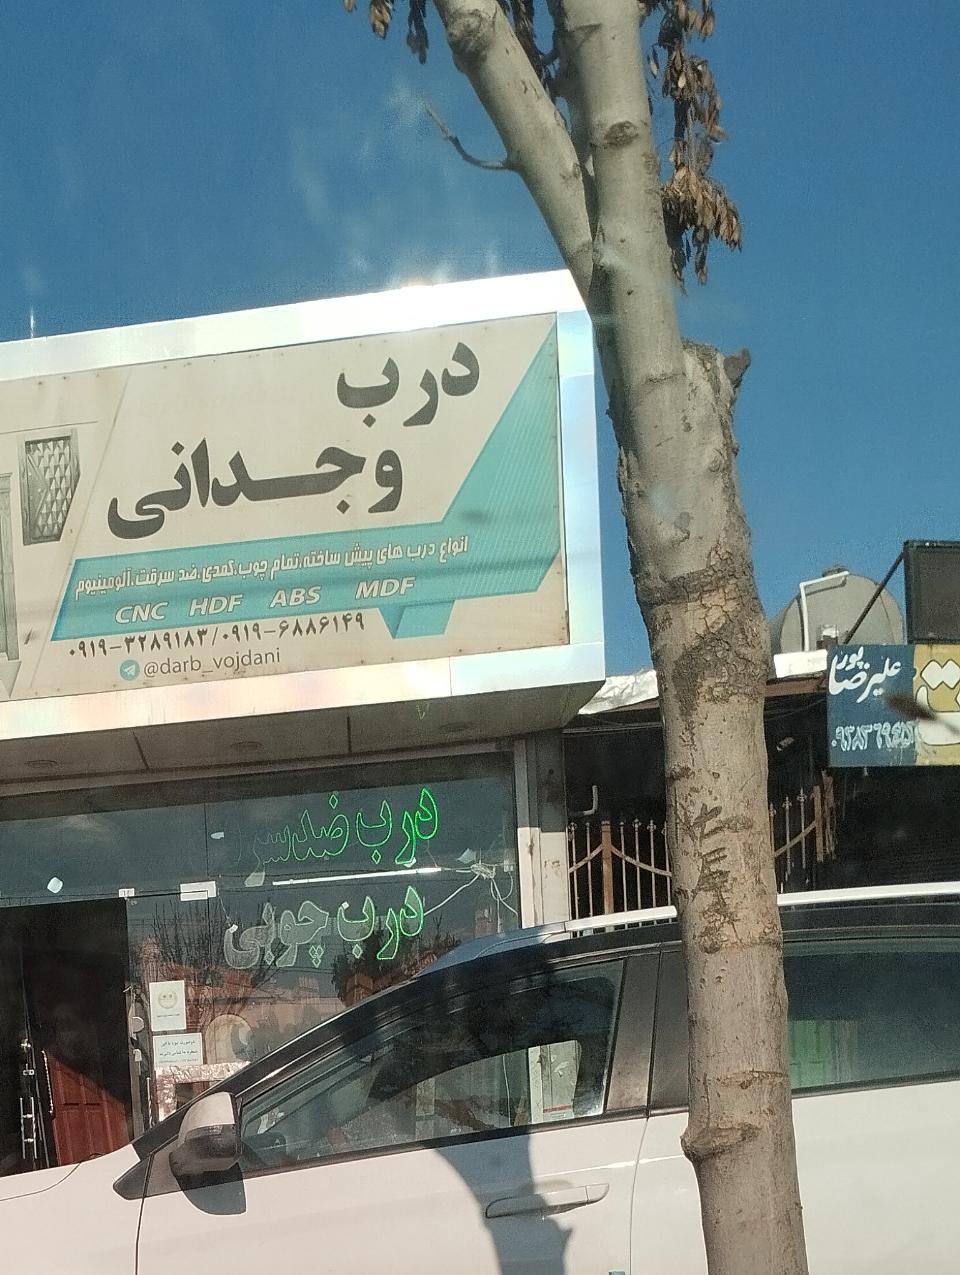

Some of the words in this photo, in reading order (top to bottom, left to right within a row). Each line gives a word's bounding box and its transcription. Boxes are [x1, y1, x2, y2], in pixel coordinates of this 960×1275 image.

[337, 341, 481, 428] درب
[107, 438, 403, 541] وجدانی
[344, 542, 374, 570] پیش
[376, 542, 403, 565] های
[406, 543, 436, 563] درب
[439, 535, 469, 564] انواع
[115, 602, 169, 624] CNC
[188, 594, 244, 617] HDF
[268, 585, 322, 608] ABS
[354, 576, 417, 600] MDF
[143, 647, 281, 677] @darb_vojdani
[828, 655, 902, 704] علیرضا
[356, 787, 439, 866] درب
[223, 900, 330, 970] چوبی
[336, 885, 424, 960] درب
